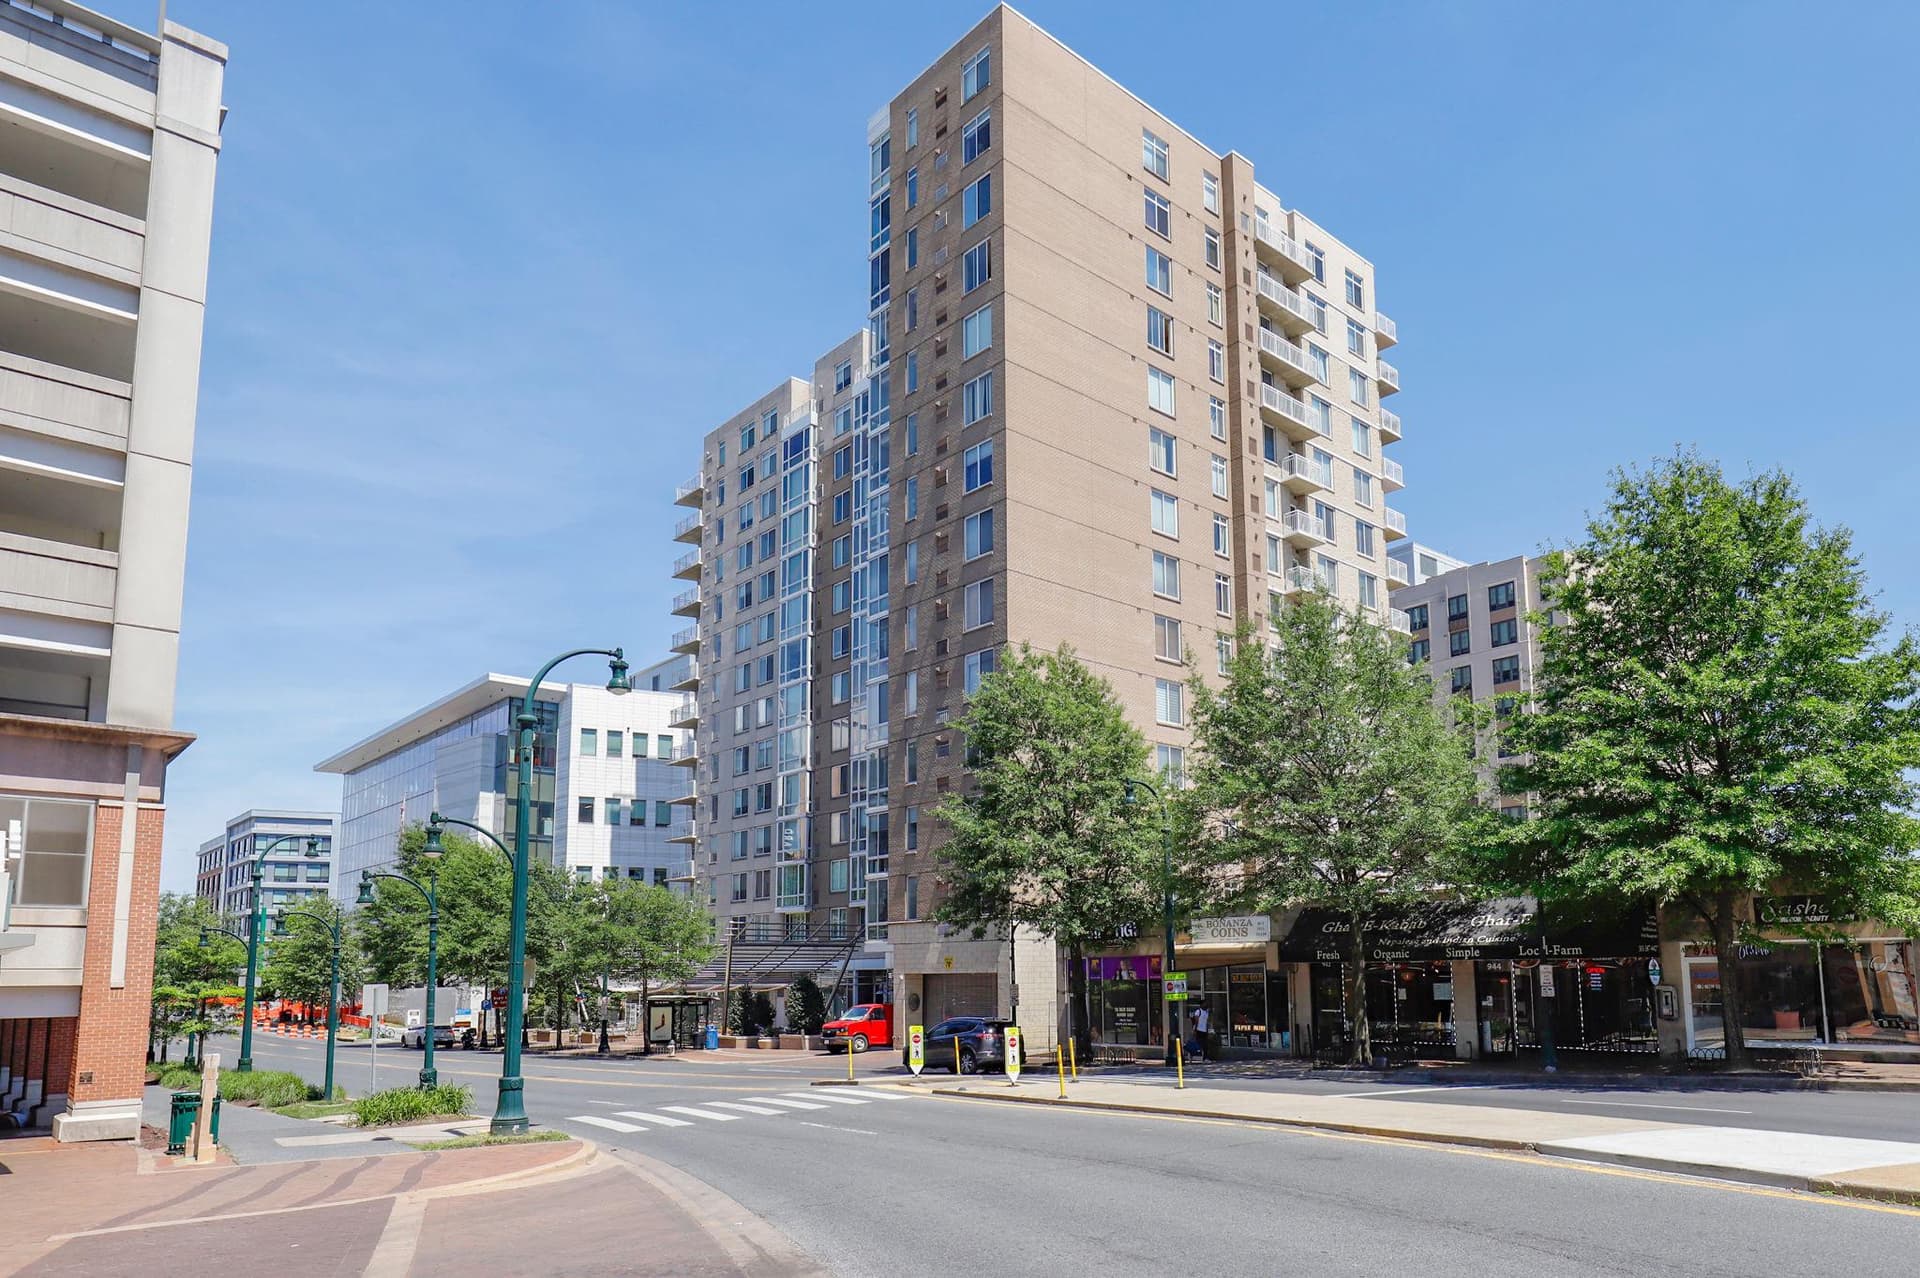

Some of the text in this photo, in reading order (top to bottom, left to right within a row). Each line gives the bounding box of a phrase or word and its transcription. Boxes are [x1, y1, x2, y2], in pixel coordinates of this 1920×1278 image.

[1206, 919, 1253, 929] BONANZA
[1211, 928, 1248, 938] COINS
[1477, 935, 1517, 944] Cuisine
[1317, 944, 1583, 961] Fresh Organic Simple Locl-Farm
